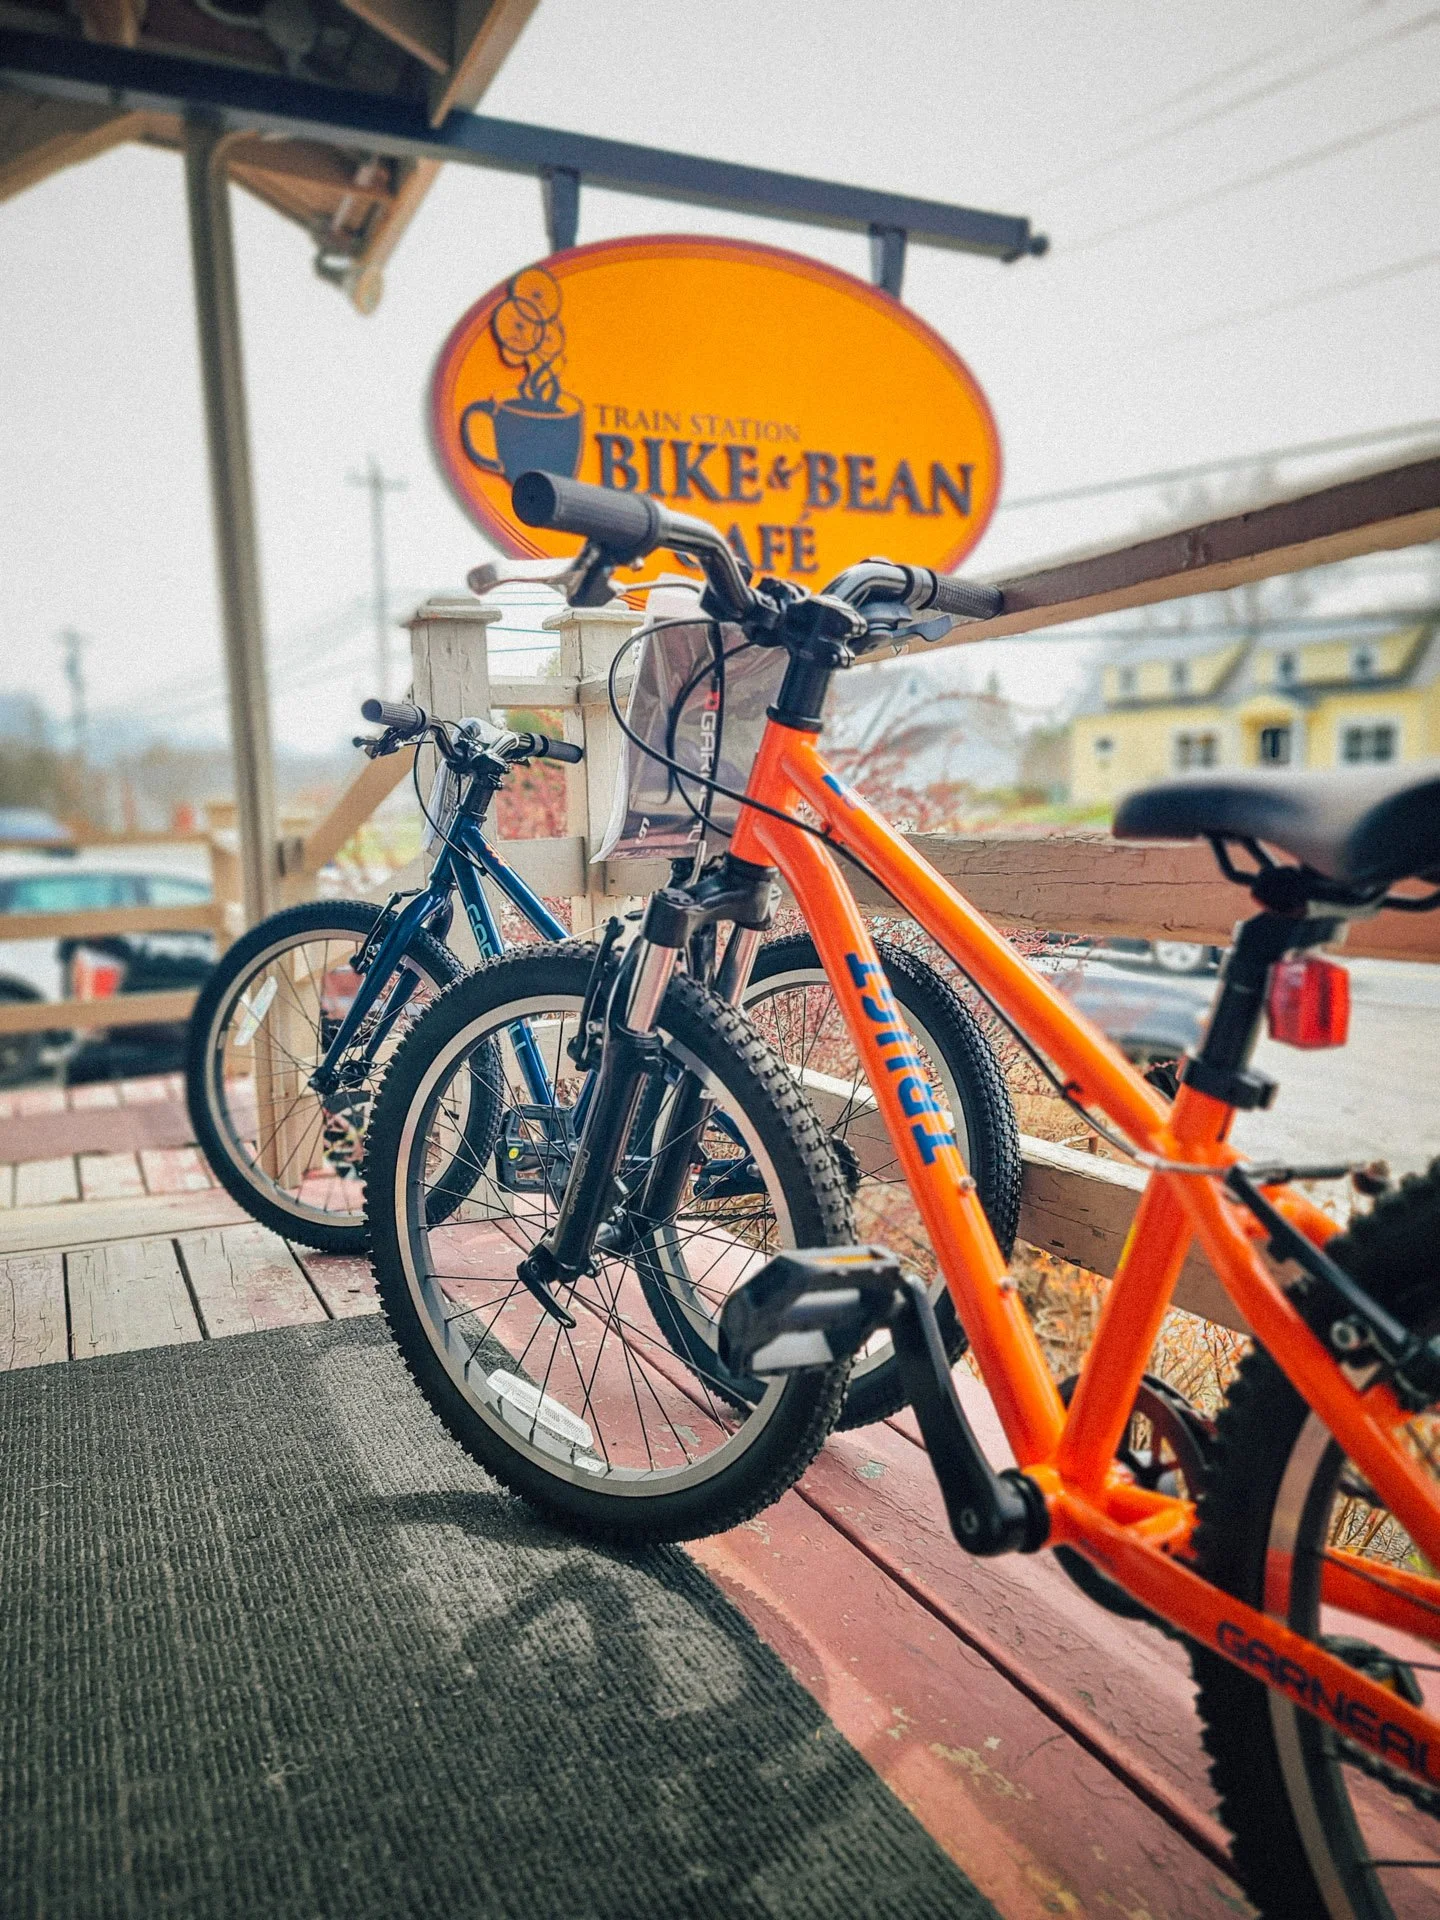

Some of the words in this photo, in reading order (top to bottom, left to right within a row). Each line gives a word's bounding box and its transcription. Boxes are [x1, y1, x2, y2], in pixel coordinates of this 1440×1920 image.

[594, 403, 682, 433] TRAIN
[688, 412, 801, 443] STATION
[594, 432, 763, 504] BIKE
[802, 450, 974, 517] BEAN
[672, 510, 818, 574] AFÉ
